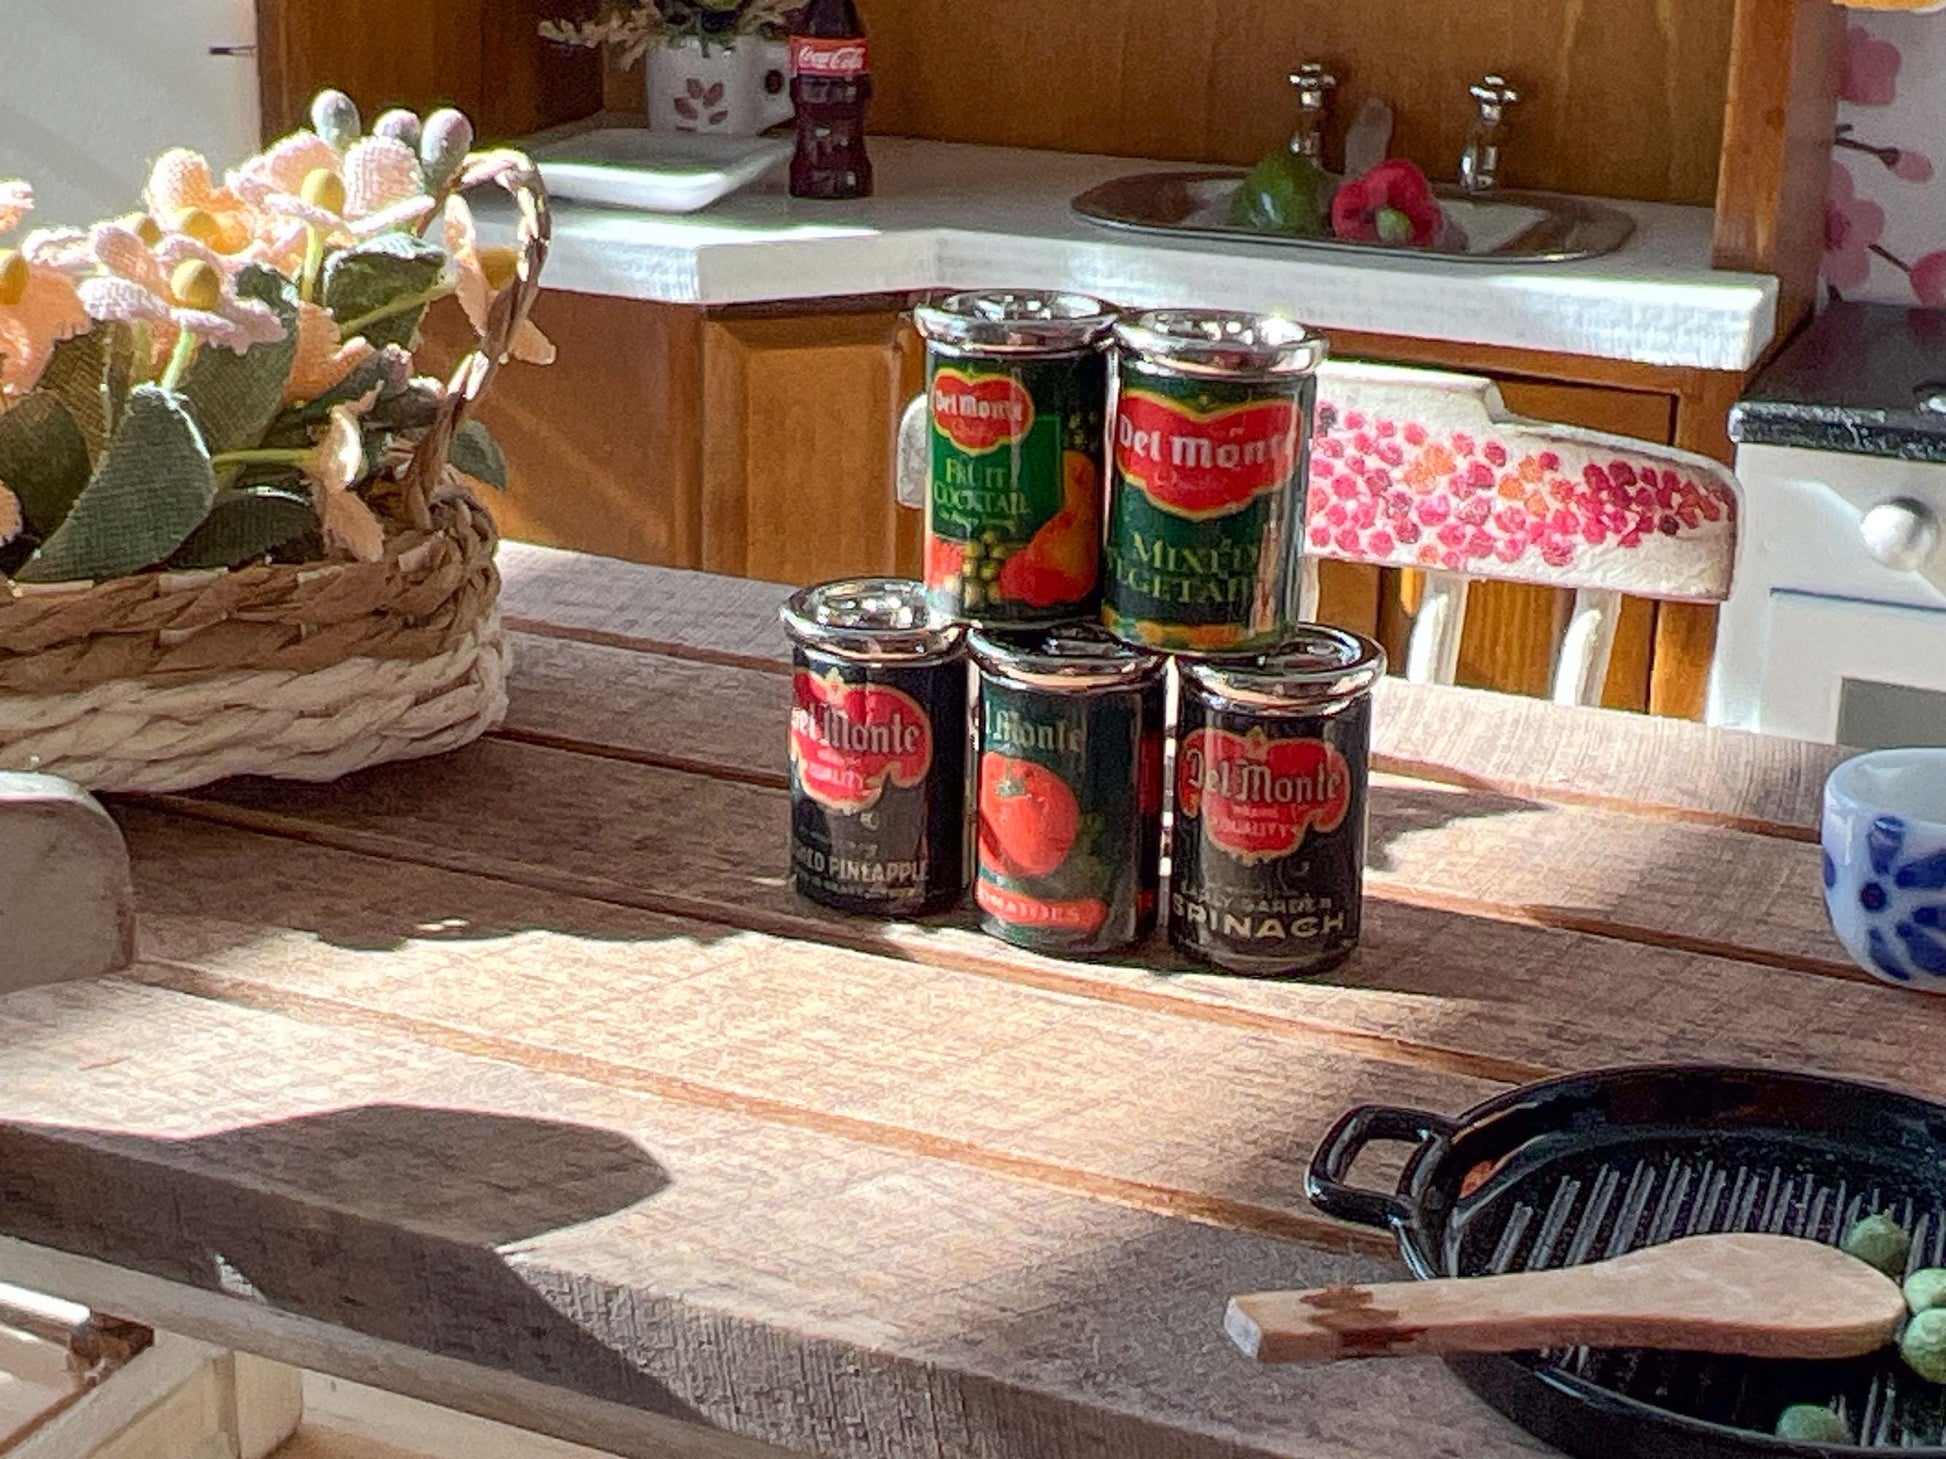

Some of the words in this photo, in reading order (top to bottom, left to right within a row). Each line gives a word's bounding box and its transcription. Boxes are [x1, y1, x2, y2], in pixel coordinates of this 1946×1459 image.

[1119, 413, 1162, 462] Del
[819, 702, 921, 754] Monte
[1187, 748, 1232, 798] Del
[1235, 758, 1341, 803] Monte
[829, 856, 928, 882] PINEAPPLE
[1173, 892, 1346, 940] SPINACH
